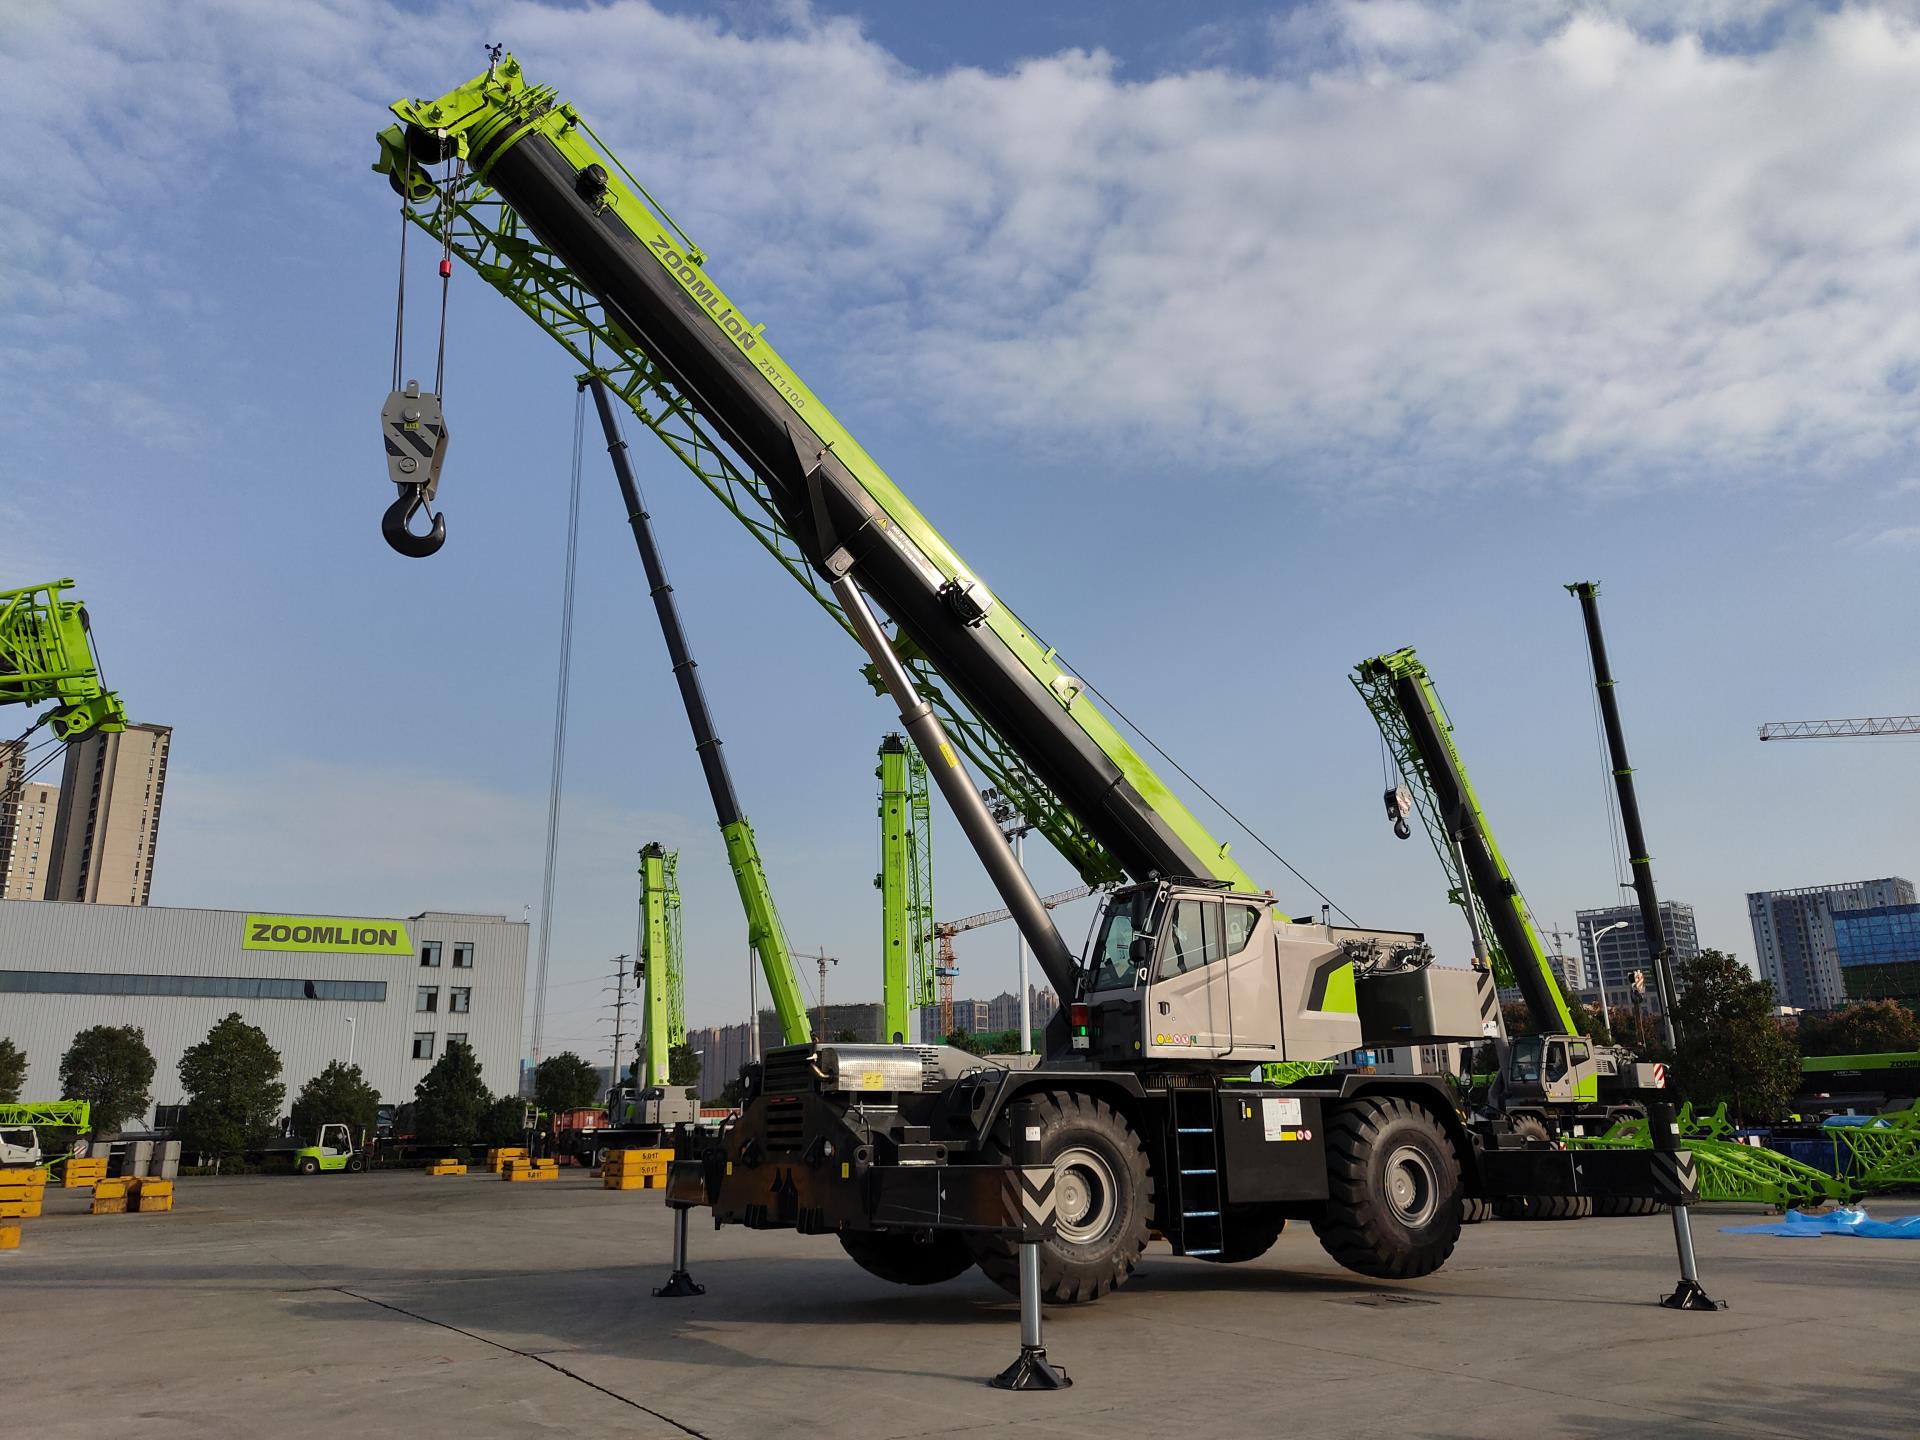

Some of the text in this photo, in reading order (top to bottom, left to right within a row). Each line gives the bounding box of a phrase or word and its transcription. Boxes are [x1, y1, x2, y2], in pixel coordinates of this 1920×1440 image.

[649, 233, 757, 351] ZOOMLION
[759, 358, 804, 408] ZRT1100
[251, 923, 398, 946] ZOOMLION
